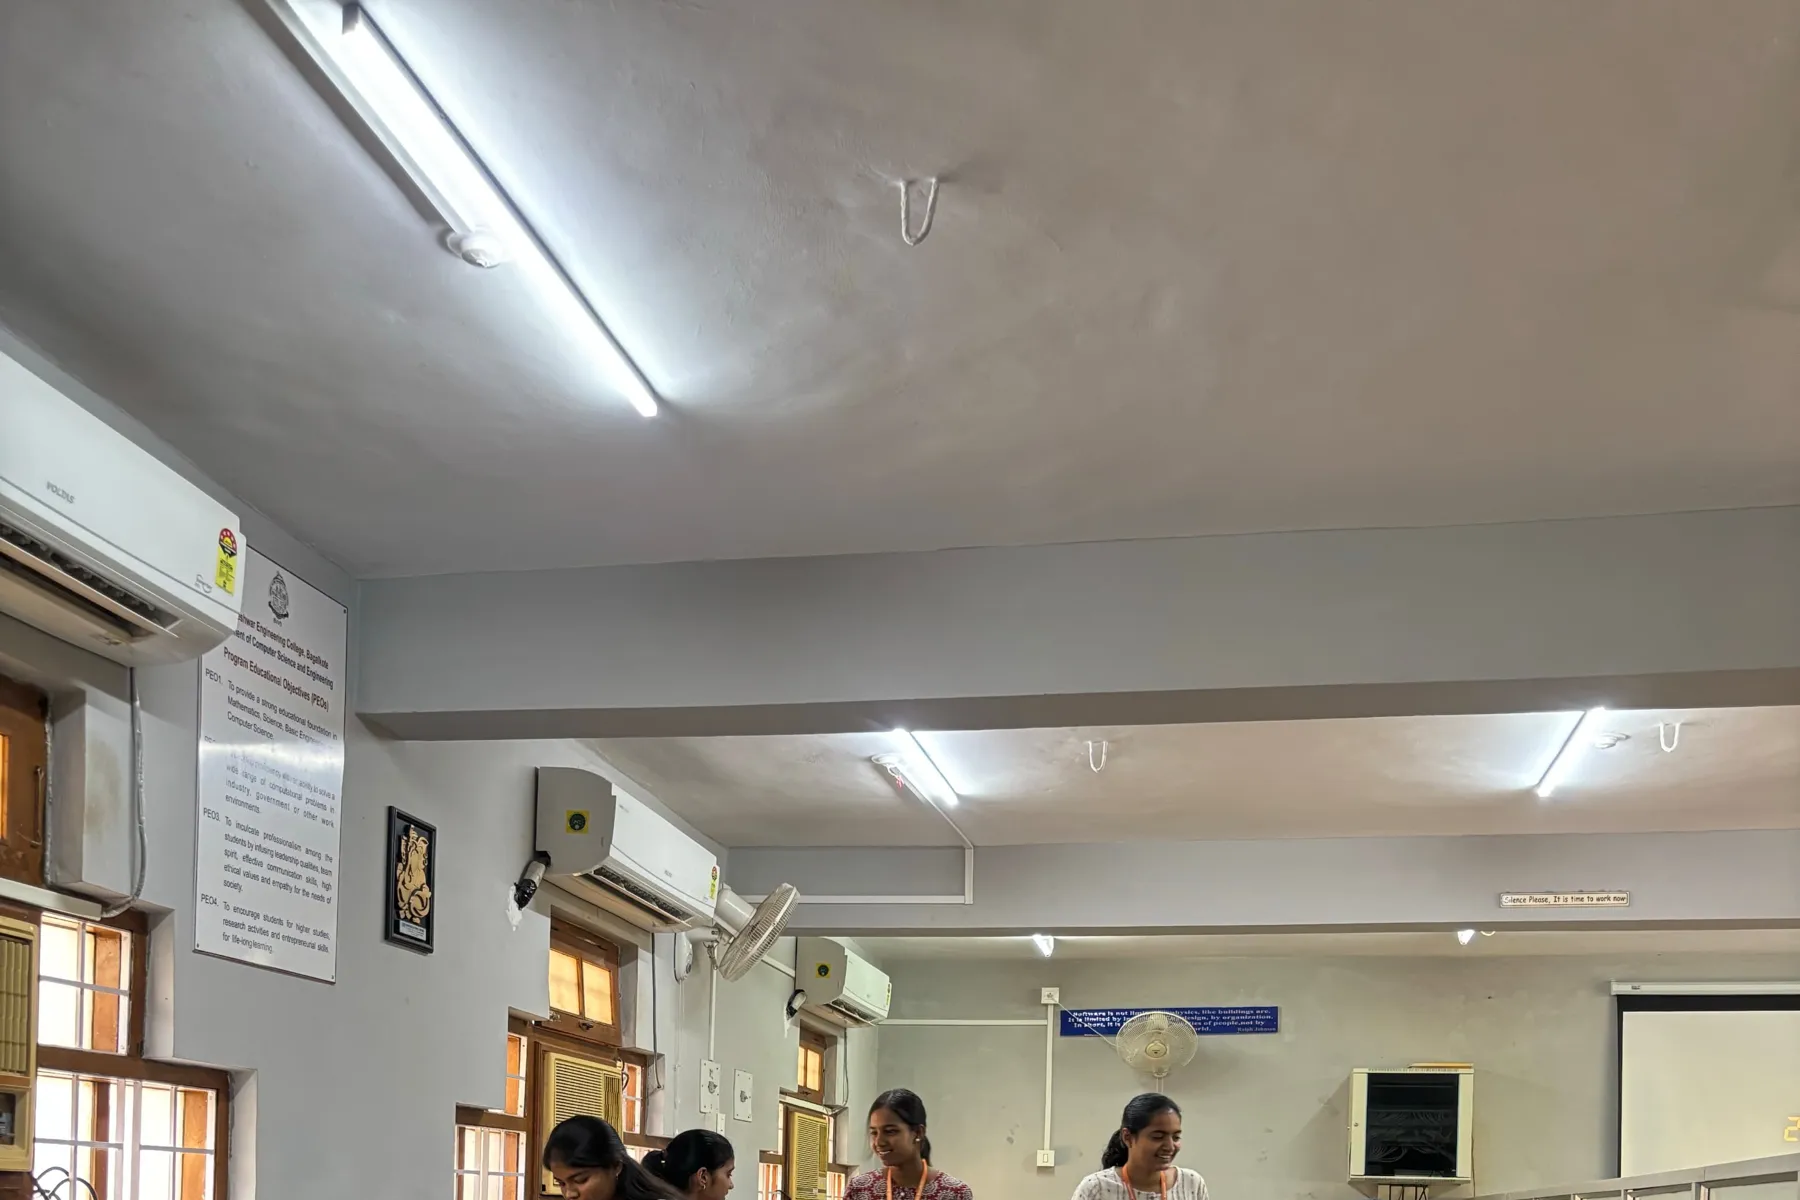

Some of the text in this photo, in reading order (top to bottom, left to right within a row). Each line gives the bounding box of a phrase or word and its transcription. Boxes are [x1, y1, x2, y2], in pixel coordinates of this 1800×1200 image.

[238, 613, 256, 628] eshwar
[256, 621, 286, 648] Engineering
[286, 639, 306, 658] College,
[223, 646, 329, 712] Program Educational Objectives (PEOs)
[246, 634, 252, 643] of
[252, 636, 276, 657] Computer
[277, 650, 296, 668] Science
[297, 662, 306, 673] and
[306, 665, 334, 690] Engineering
[227, 680, 234, 691] To
[235, 686, 255, 701] provide
[261, 699, 278, 714] strong
[278, 707, 306, 726] educational
[307, 719, 332, 737] foundation
[332, 732, 338, 741] in
[227, 696, 262, 721] Mathematics,
[263, 713, 284, 731] Science,
[285, 724, 299, 737] Basic
[227, 711, 274, 741] Computer Science.
[203, 807, 221, 822] PEO3.
[255, 791, 290, 811] government
[293, 806, 300, 814] or
[303, 810, 318, 821] other
[321, 817, 335, 828] work
[269, 783, 303, 801] computational
[305, 797, 327, 811] problems
[329, 805, 335, 814] in
[224, 816, 333, 863] To inculcate professionalism among the
[224, 832, 247, 848] students
[247, 840, 254, 852] by
[254, 843, 274, 858] infusing
[274, 850, 300, 866] leadership
[320, 866, 333, 877] team
[223, 864, 332, 905] ethical values and empathy for the needs of
[242, 854, 264, 868] effective
[266, 863, 303, 880] communication
[321, 880, 333, 892] high
[222, 901, 231, 911] To
[232, 905, 260, 920] encourage
[263, 912, 284, 926] students
[286, 919, 294, 929] for
[295, 922, 311, 936] higher
[1504, 896, 1527, 904] Silence
[1528, 896, 1551, 904] Please,
[1553, 895, 1560, 903] It
[1570, 895, 1584, 903] time
[222, 918, 246, 930] research
[247, 924, 270, 937] activities
[270, 930, 281, 940] and
[281, 934, 316, 950] entrepreneurial
[222, 932, 231, 942] for
[231, 934, 253, 949] life-long
